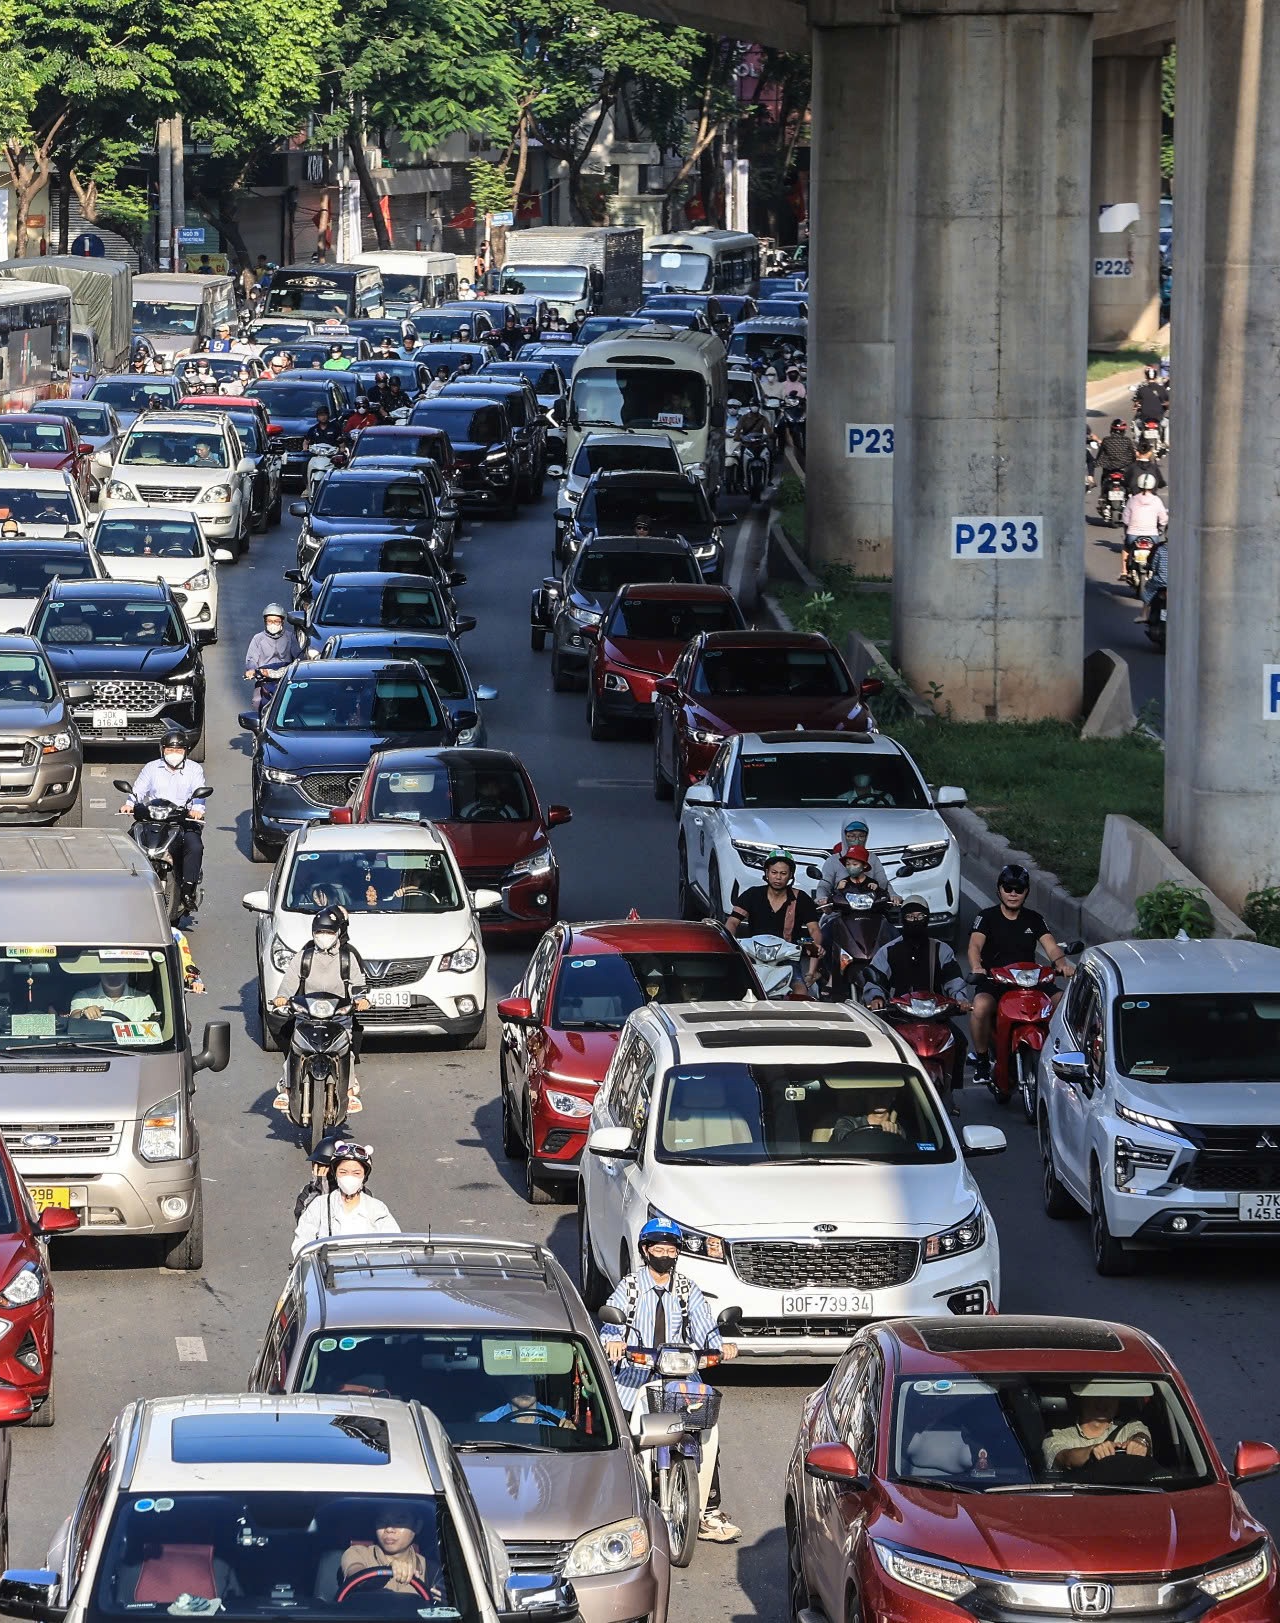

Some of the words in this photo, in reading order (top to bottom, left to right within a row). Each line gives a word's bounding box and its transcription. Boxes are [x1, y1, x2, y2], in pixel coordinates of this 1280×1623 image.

[956, 521, 1039, 554] P233
[97, 718, 124, 727] 316.49
[115, 1023, 157, 1038] HLX
[30, 1189, 54, 1200] 29B
[1256, 1194, 1280, 1206] 37K
[786, 1296, 869, 1313] 30F-739.34
